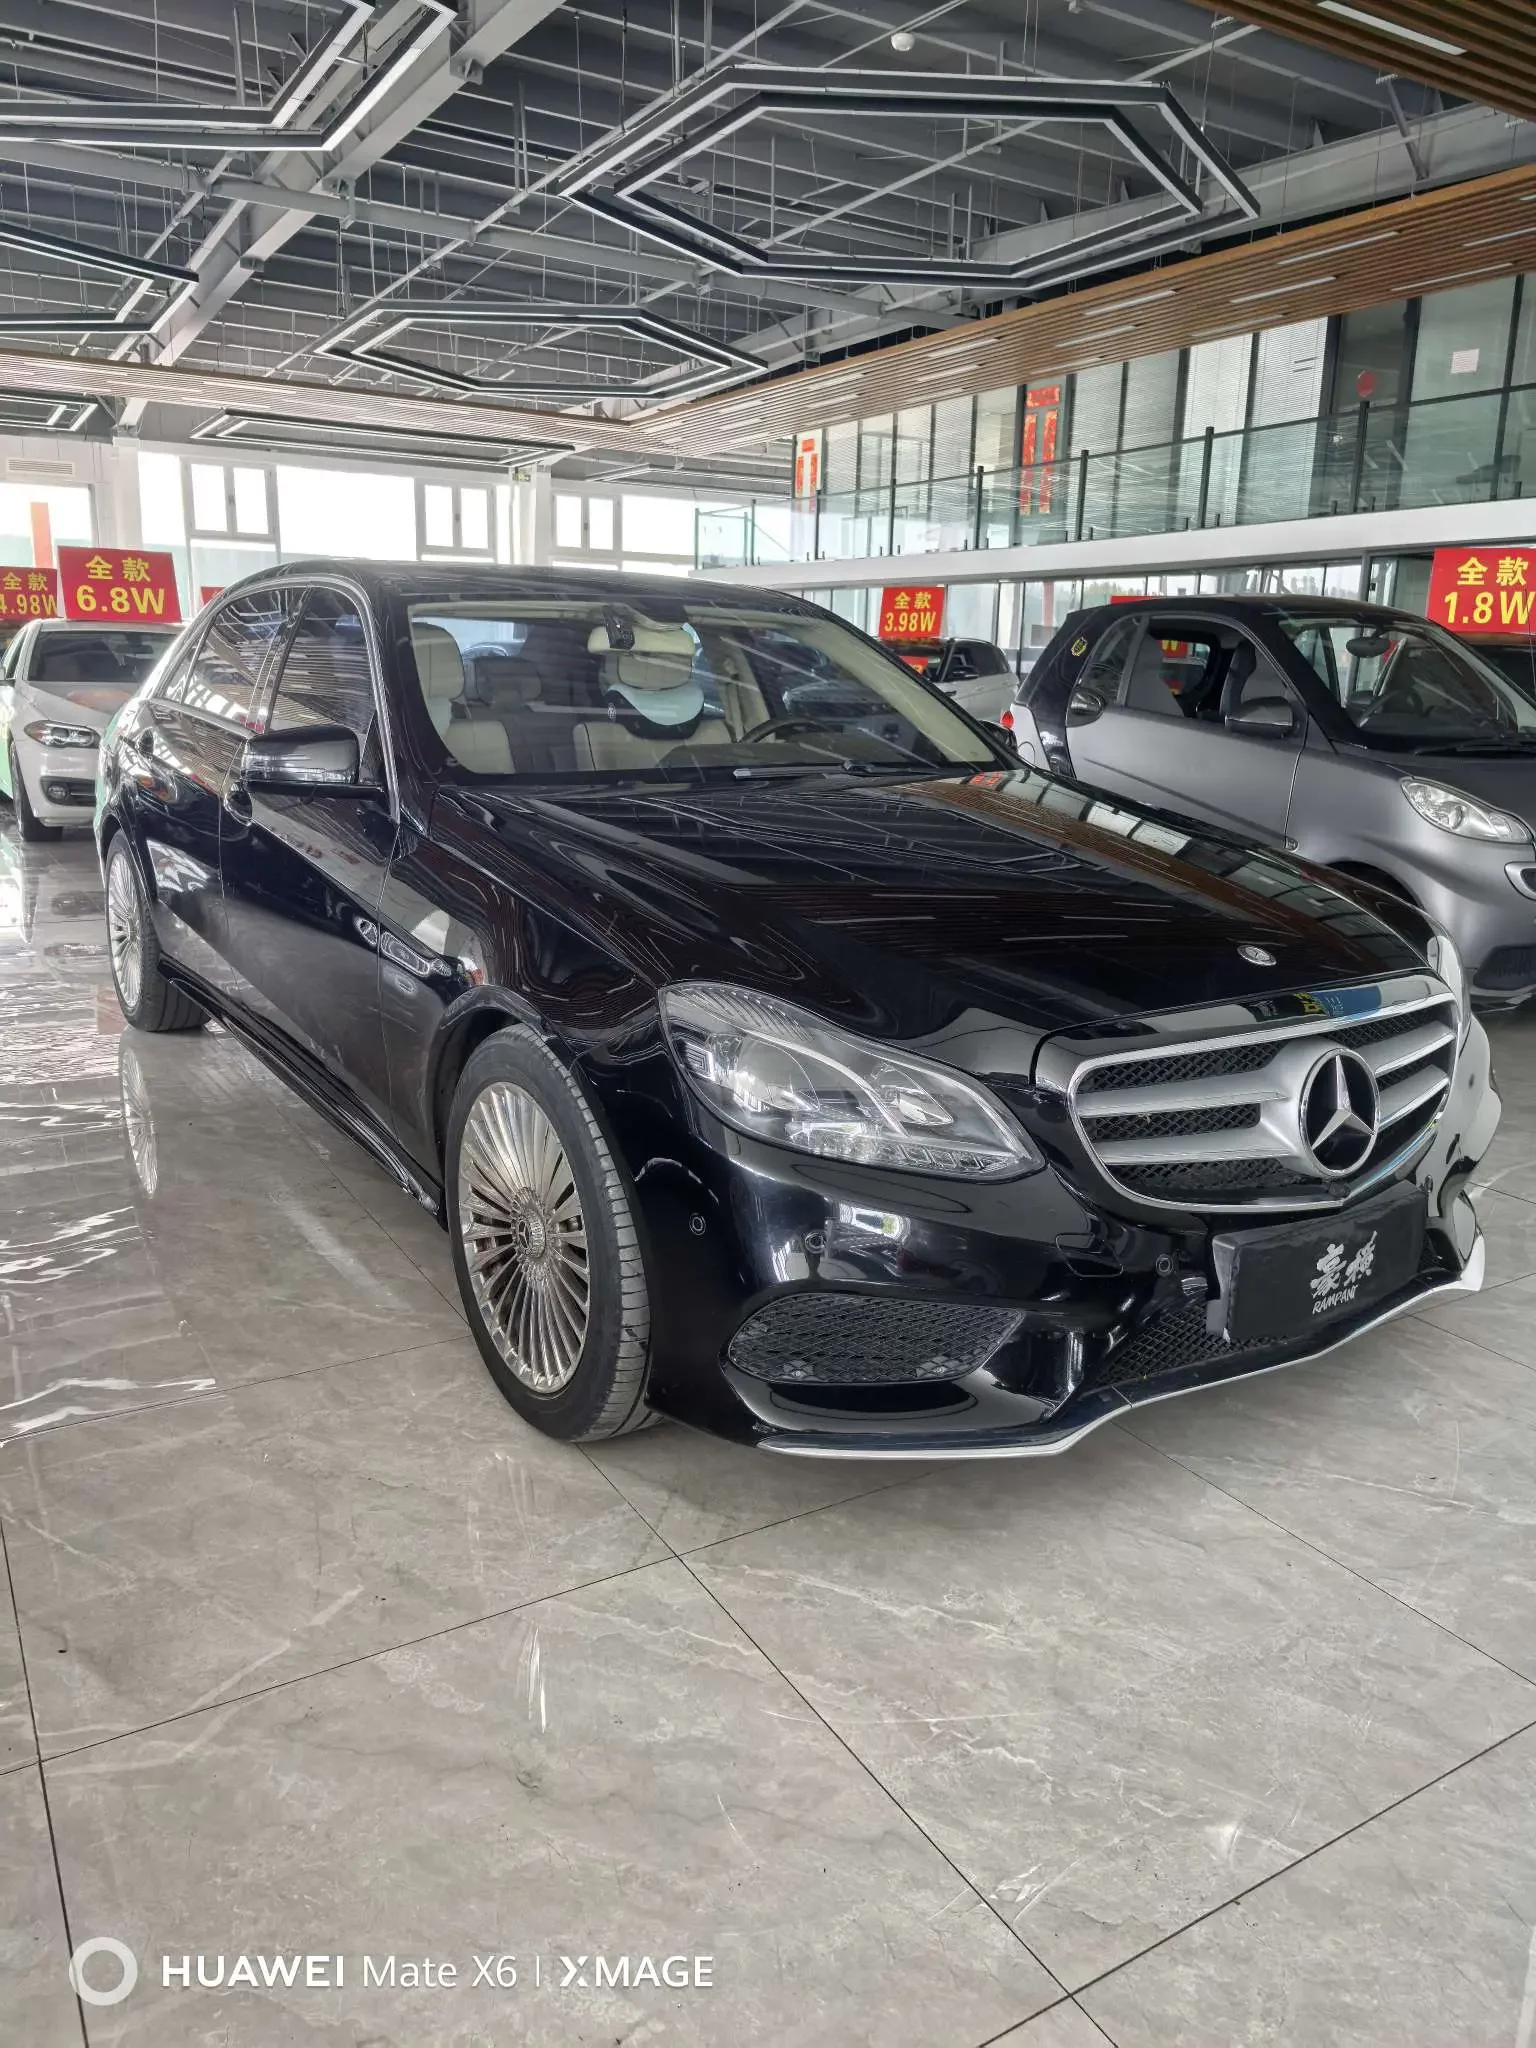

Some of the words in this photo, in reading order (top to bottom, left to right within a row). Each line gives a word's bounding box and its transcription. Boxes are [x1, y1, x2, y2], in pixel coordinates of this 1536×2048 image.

[3, 572, 48, 591] 全款
[86, 555, 151, 582] 全款
[1457, 556, 1529, 586] 全款
[77, 585, 164, 614] 6.8W
[895, 592, 931, 609] 全款
[1444, 591, 1536, 624] 1.8W
[885, 612, 936, 632] 3.98W
